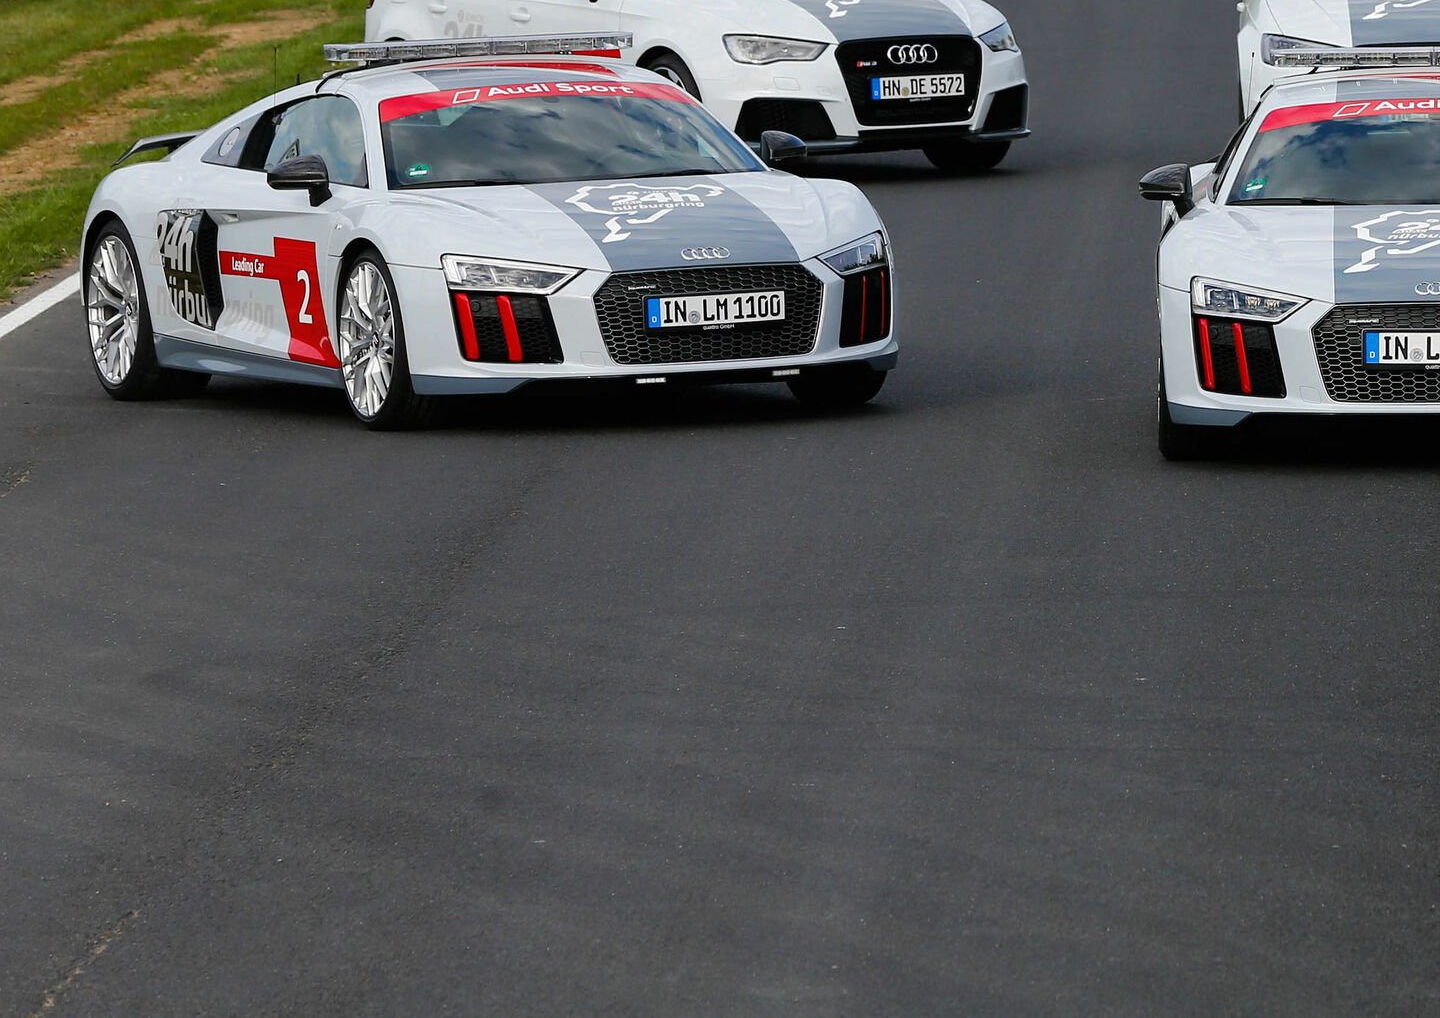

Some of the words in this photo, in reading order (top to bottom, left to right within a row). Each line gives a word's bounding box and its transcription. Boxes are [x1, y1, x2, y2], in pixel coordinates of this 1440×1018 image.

[488, 83, 550, 97] Audi
[555, 83, 635, 94] Sport
[883, 79, 900, 96] HN
[911, 78, 927, 95] DE
[930, 76, 963, 94] 5572
[608, 193, 702, 206] 24h
[231, 256, 254, 276] Leading
[254, 259, 265, 274] Car
[297, 269, 313, 324] 2
[663, 300, 687, 324] IN
[1382, 336, 1408, 360] IN
